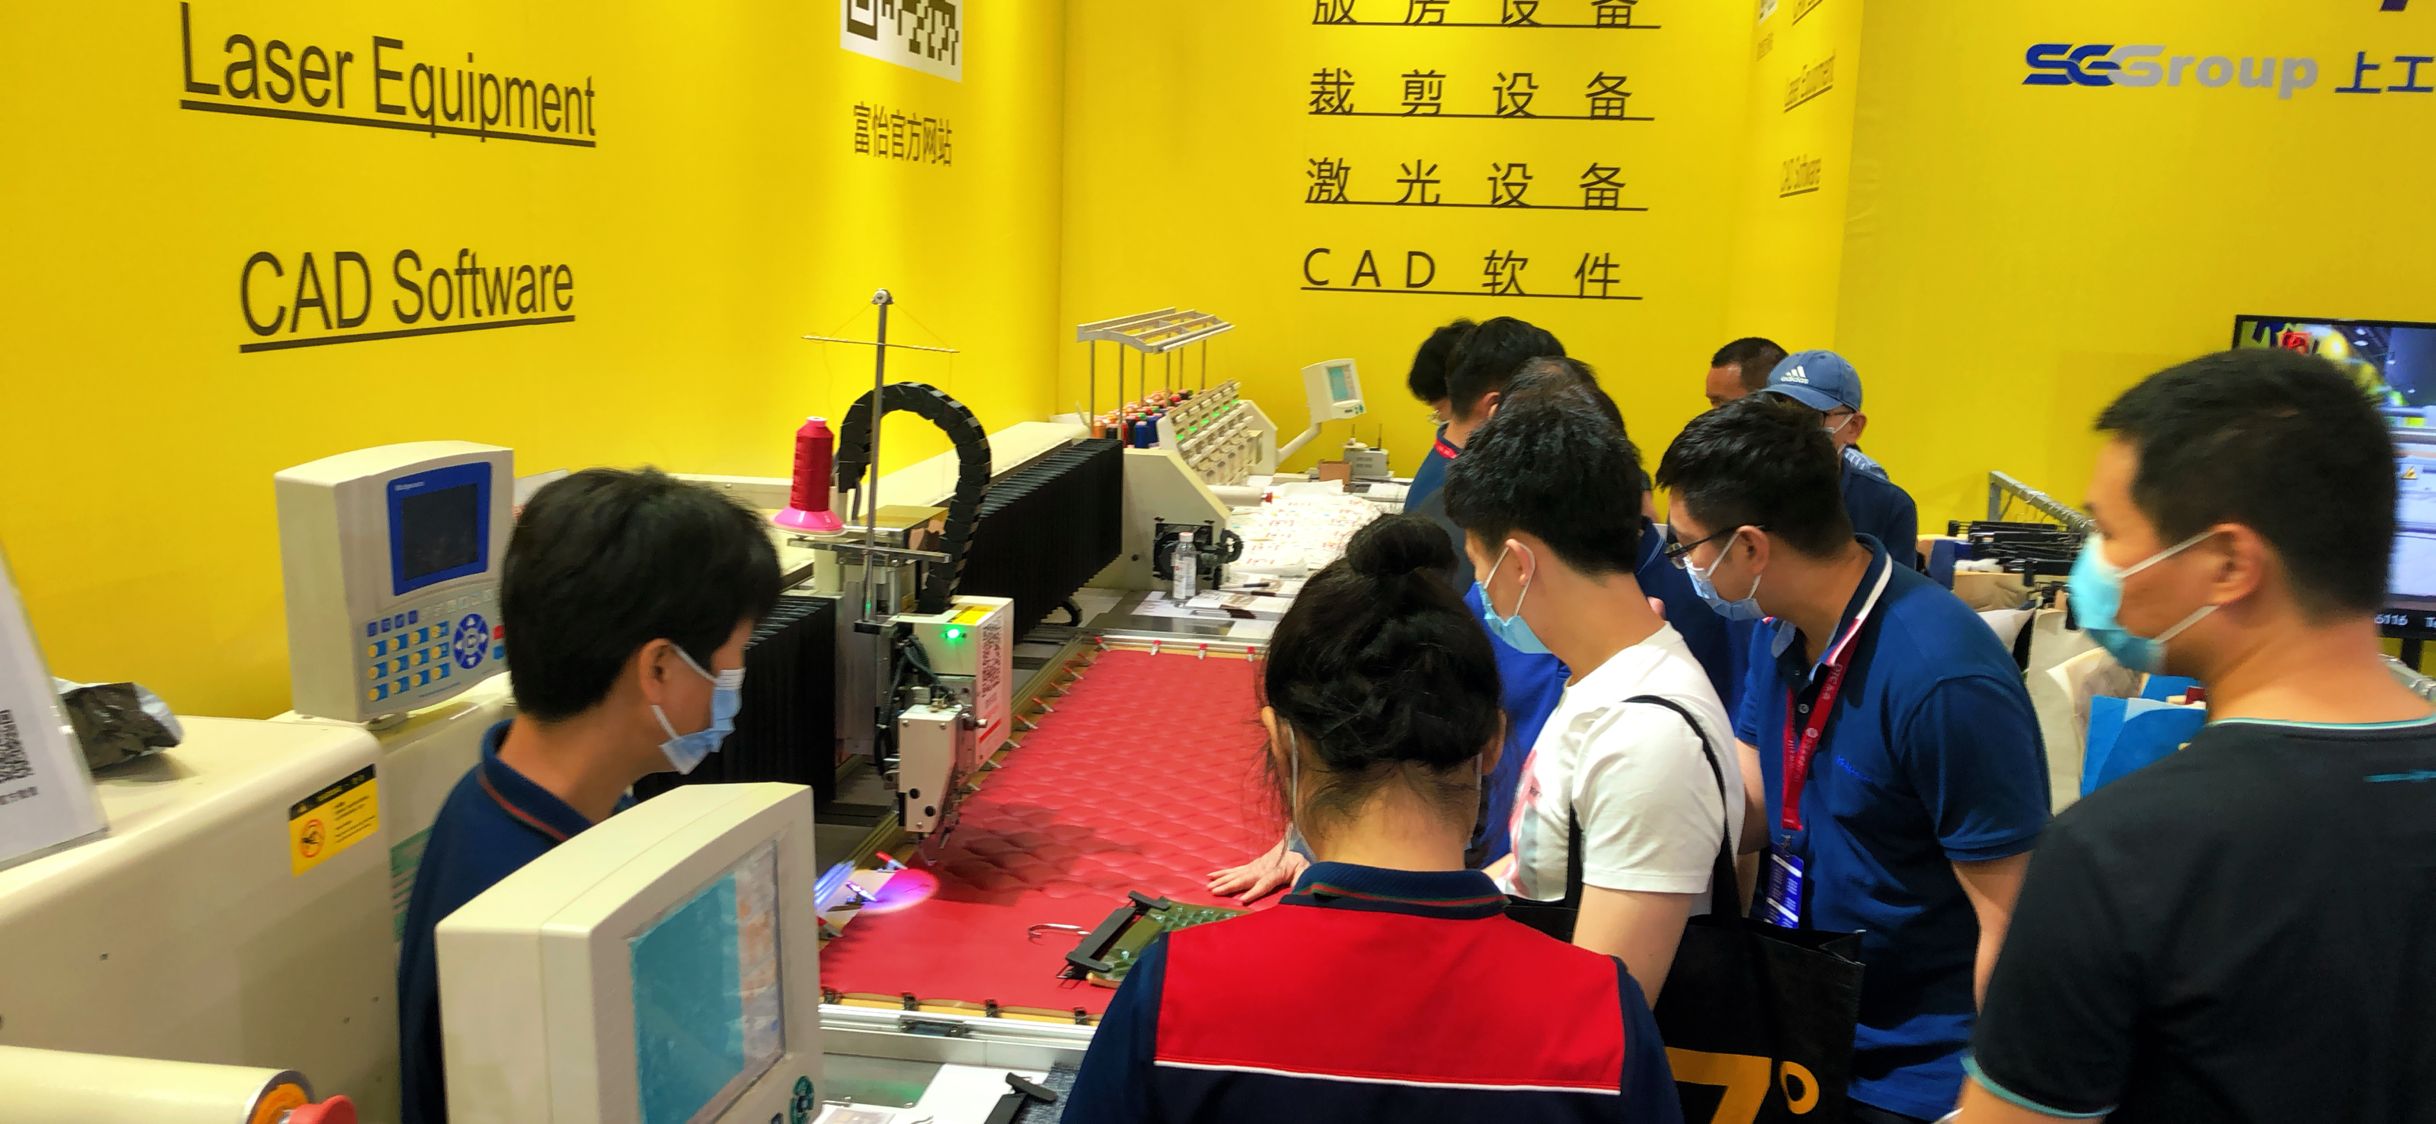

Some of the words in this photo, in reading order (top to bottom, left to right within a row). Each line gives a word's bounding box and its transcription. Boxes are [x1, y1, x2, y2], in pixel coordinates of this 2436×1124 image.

[180, 1, 354, 110] Laser
[372, 35, 597, 143] Equipment
[1308, 67, 1633, 121] 裁剪设备
[853, 100, 953, 167] 富怡官方网站
[1305, 156, 1626, 211] 激光设备
[240, 250, 372, 337] CAD
[392, 247, 574, 326] Software
